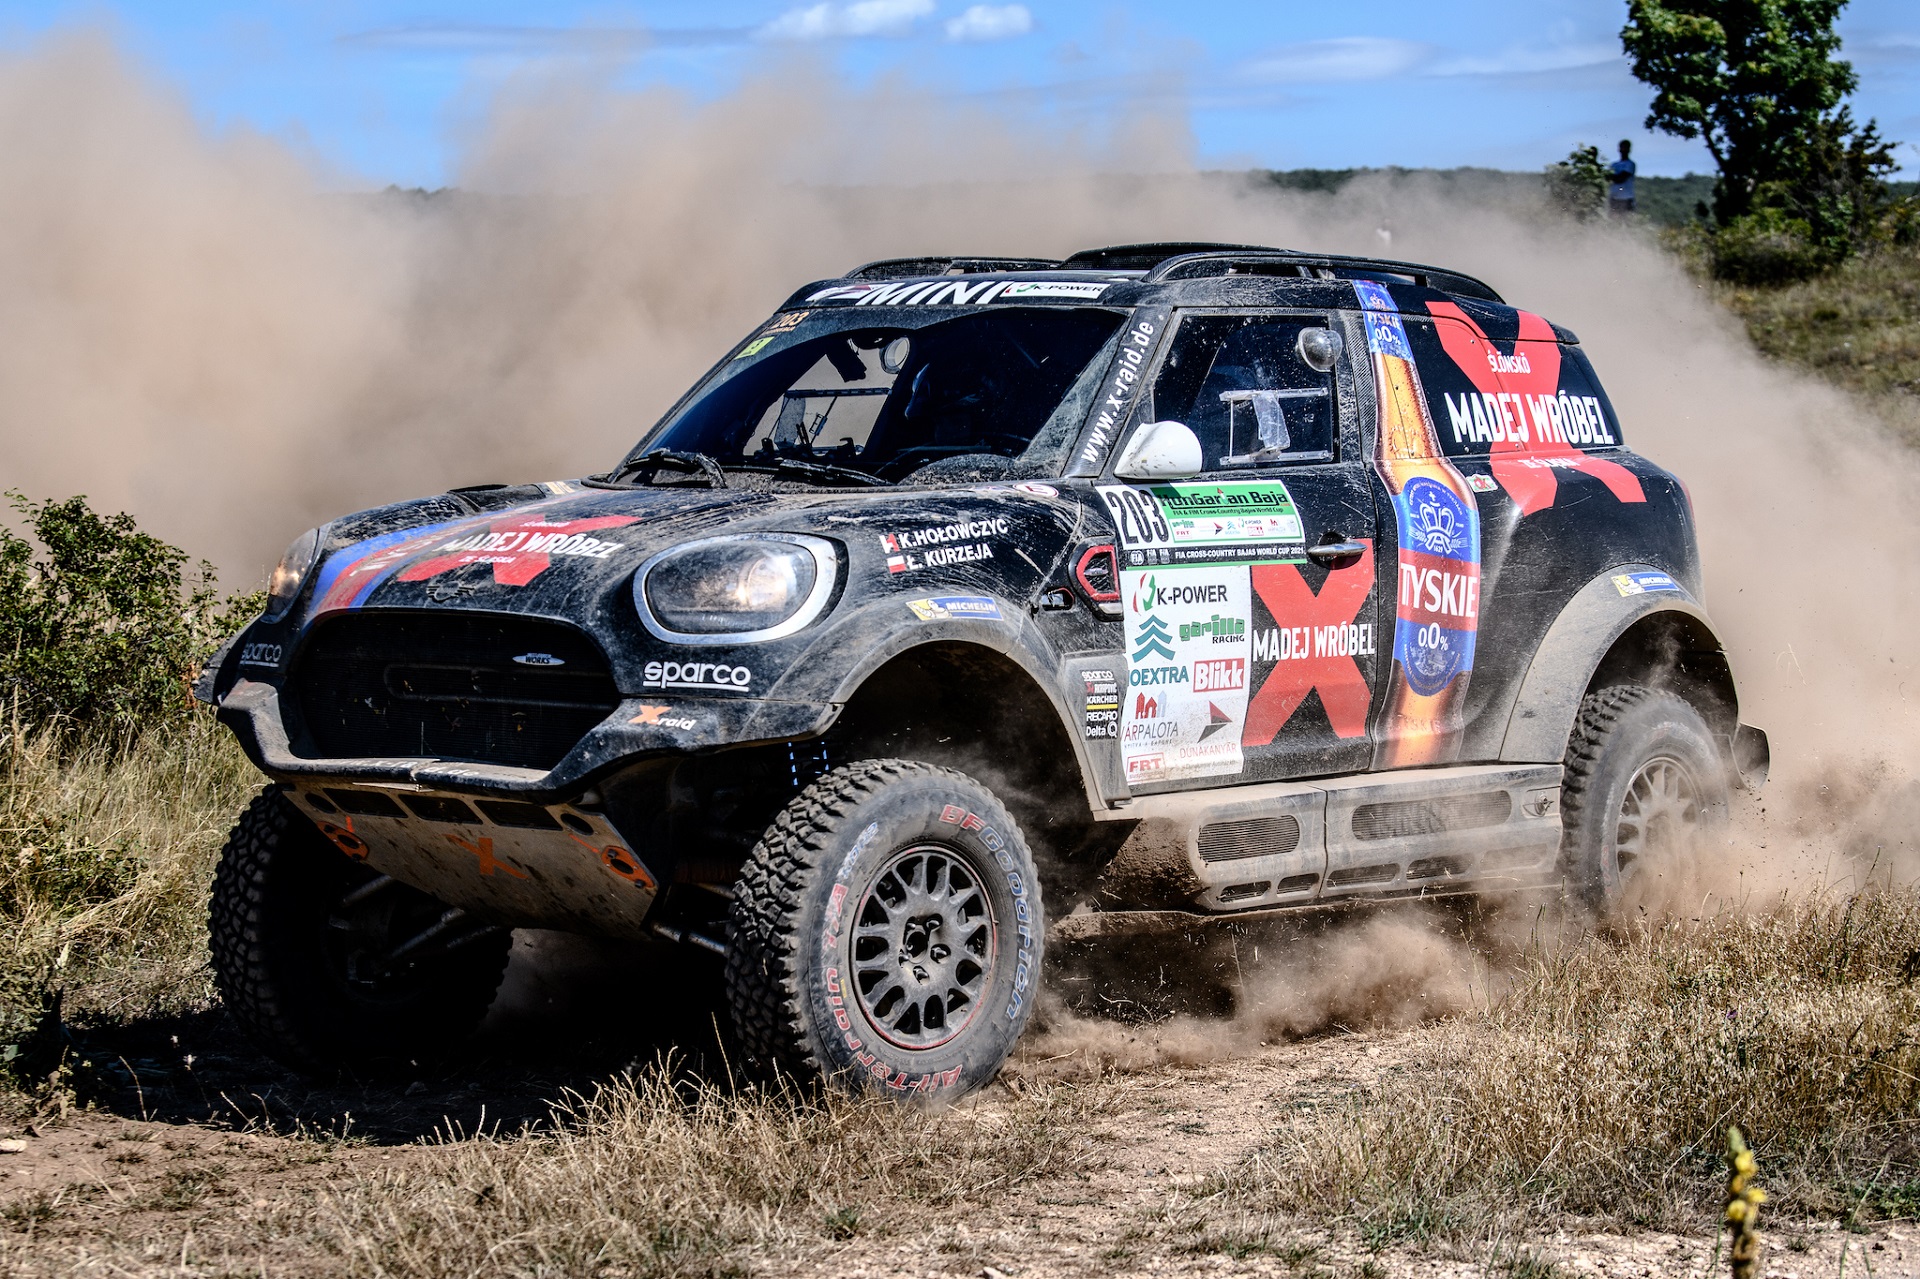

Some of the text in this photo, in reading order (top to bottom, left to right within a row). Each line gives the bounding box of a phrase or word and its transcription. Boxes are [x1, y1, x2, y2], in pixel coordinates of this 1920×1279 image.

[855, 281, 1015, 306] MINI
[1033, 284, 1103, 292] K-POWER
[1080, 321, 1154, 463] www.x-raid.de
[1443, 389, 1614, 445] MADEJ WRÓBEL
[1248, 490, 1289, 506] Baja
[1106, 489, 1170, 545] 203
[431, 531, 626, 560] MADEJ WRÓBEL
[899, 518, 1009, 549] K.HOŁOWCZYC
[907, 542, 994, 570] Ł. KURZEJA
[1175, 551, 1186, 559] FIA
[1186, 548, 1236, 559] CROSS-COUNTRY
[1237, 547, 1256, 556] BAJAS
[1256, 547, 1278, 555] WORLD
[1278, 546, 1290, 555] CUP
[1157, 585, 1228, 606] K-POWER
[1400, 562, 1478, 618] TYSKIE
[946, 601, 997, 612] MICHELIN
[1179, 614, 1245, 642] garilla
[1212, 635, 1245, 644] RACING
[1417, 622, 1448, 651] 0.0%
[240, 643, 282, 666] sparco
[1252, 620, 1376, 663] MADEJ WRÓBEL
[525, 656, 551, 665] WORKS
[643, 661, 751, 690] sparco
[1082, 671, 1115, 681] sparco
[1129, 666, 1190, 687] OEXTRA
[1194, 660, 1244, 691] Blikk
[628, 705, 697, 731] X-raid
[1086, 711, 1118, 721] RECARO
[1086, 721, 1118, 738] Delta Q
[1129, 758, 1162, 772] FRT
[938, 804, 1033, 1020] BFGoodrich
[825, 967, 964, 1093] All-Terrain
